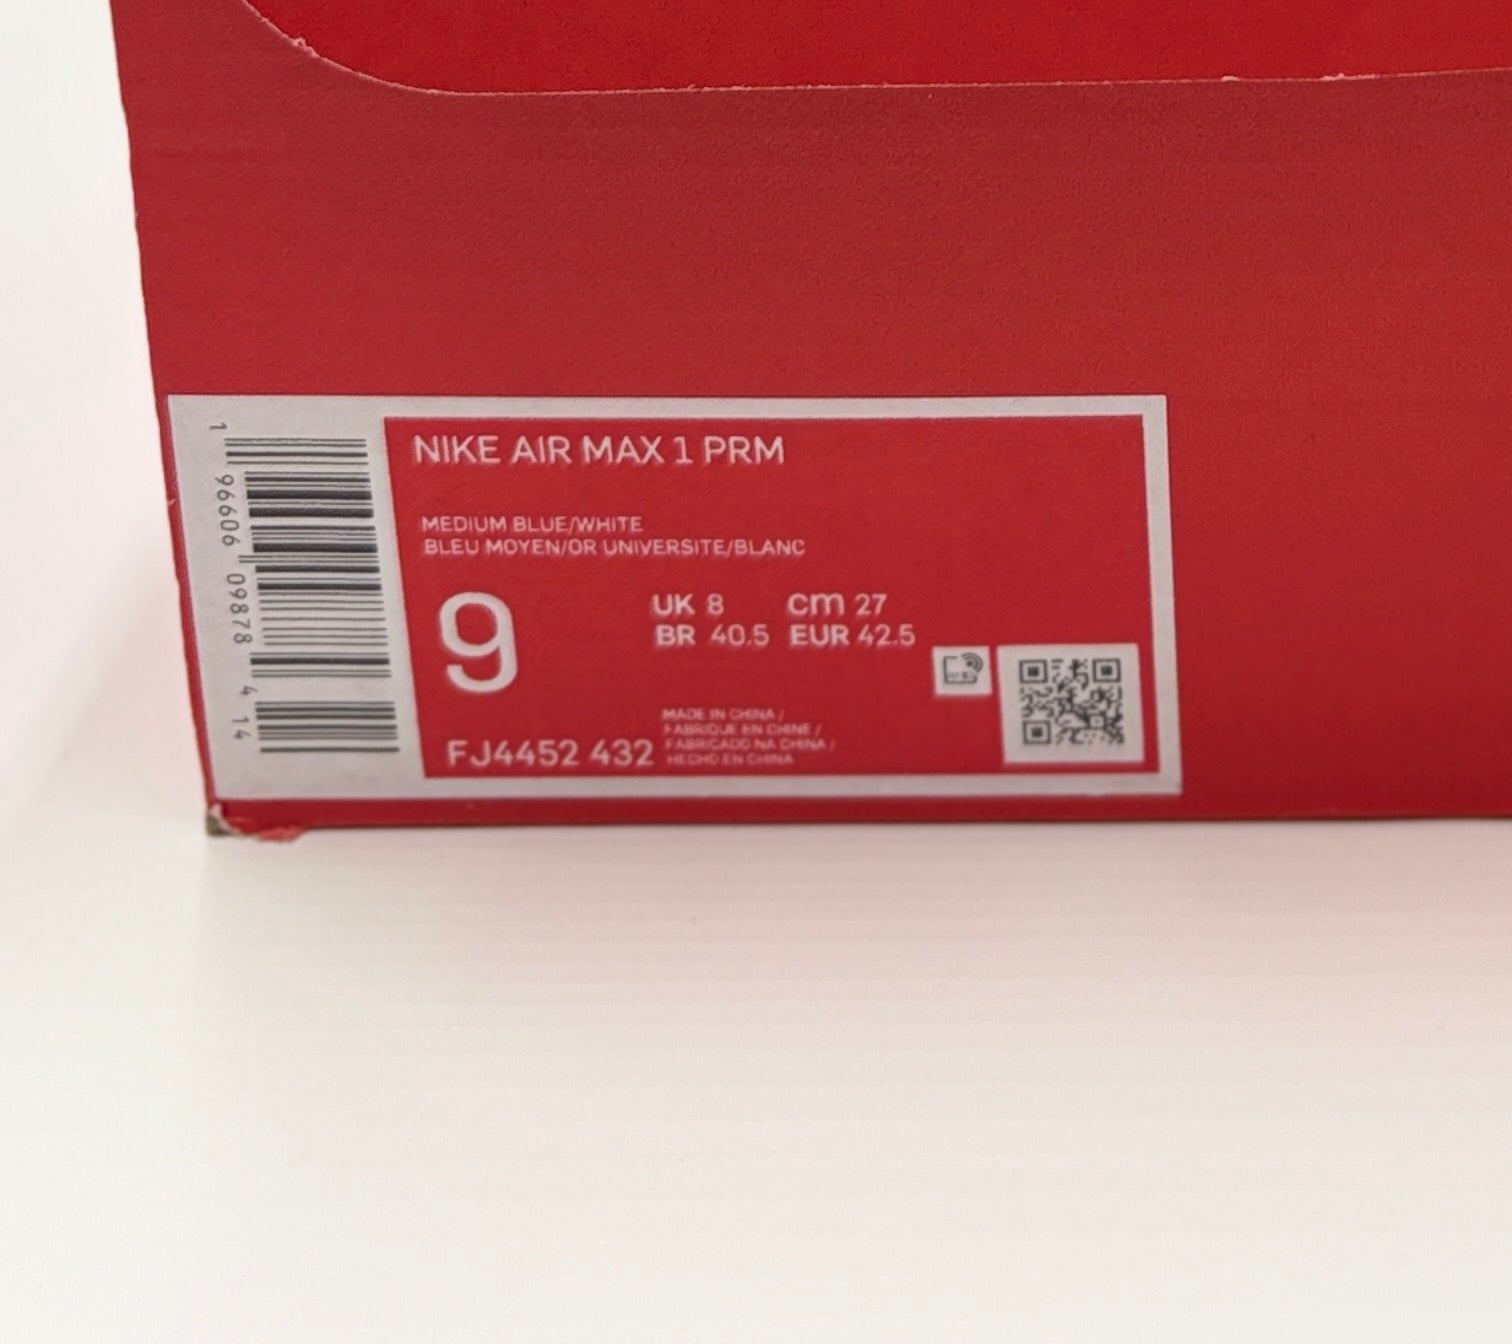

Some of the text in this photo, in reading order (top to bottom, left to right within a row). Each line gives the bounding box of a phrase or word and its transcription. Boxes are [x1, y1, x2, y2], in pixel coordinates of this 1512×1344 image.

[413, 434, 786, 465] NIKE AIR MAX 1 PRM
[215, 474, 241, 547] 96606
[421, 515, 643, 533] MEDIUM BLUE/WHITE
[424, 538, 806, 556] BLEU MOYEN/OR UNIVERSITE/BLANC
[226, 573, 253, 645] 09878
[653, 594, 724, 615] UK 8
[787, 593, 887, 615] cm 27
[438, 591, 518, 692] 9
[655, 625, 770, 646] BR 40.5
[790, 625, 915, 646] EUR 42.5
[447, 740, 654, 767] FJ4452 432
